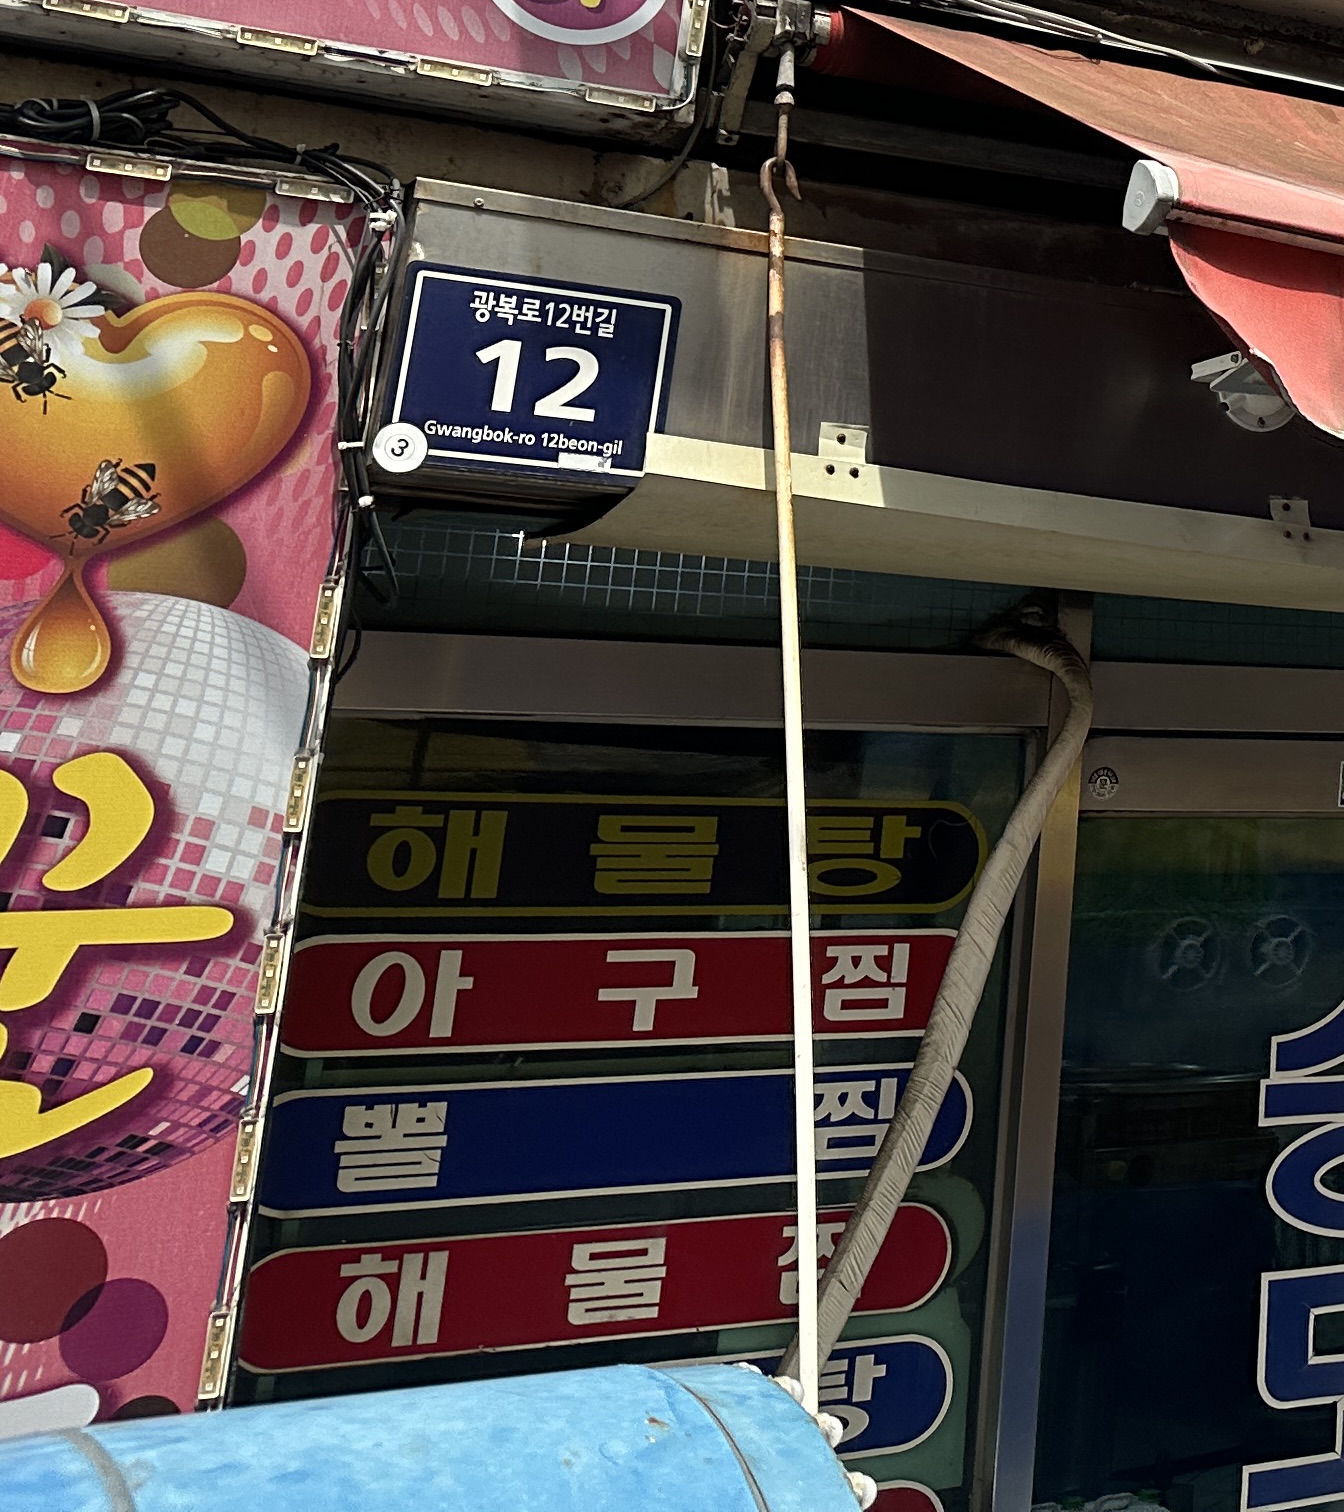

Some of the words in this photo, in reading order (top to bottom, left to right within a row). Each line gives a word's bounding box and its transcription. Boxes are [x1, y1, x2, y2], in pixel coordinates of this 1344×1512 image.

[470, 290, 618, 338] 광복로12번길
[475, 339, 600, 423] 12
[391, 438, 409, 457] 3
[424, 419, 536, 446] Gwangbok-ro
[541, 432, 623, 457] 12beon-gil
[350, 942, 910, 1039] 아구찜
